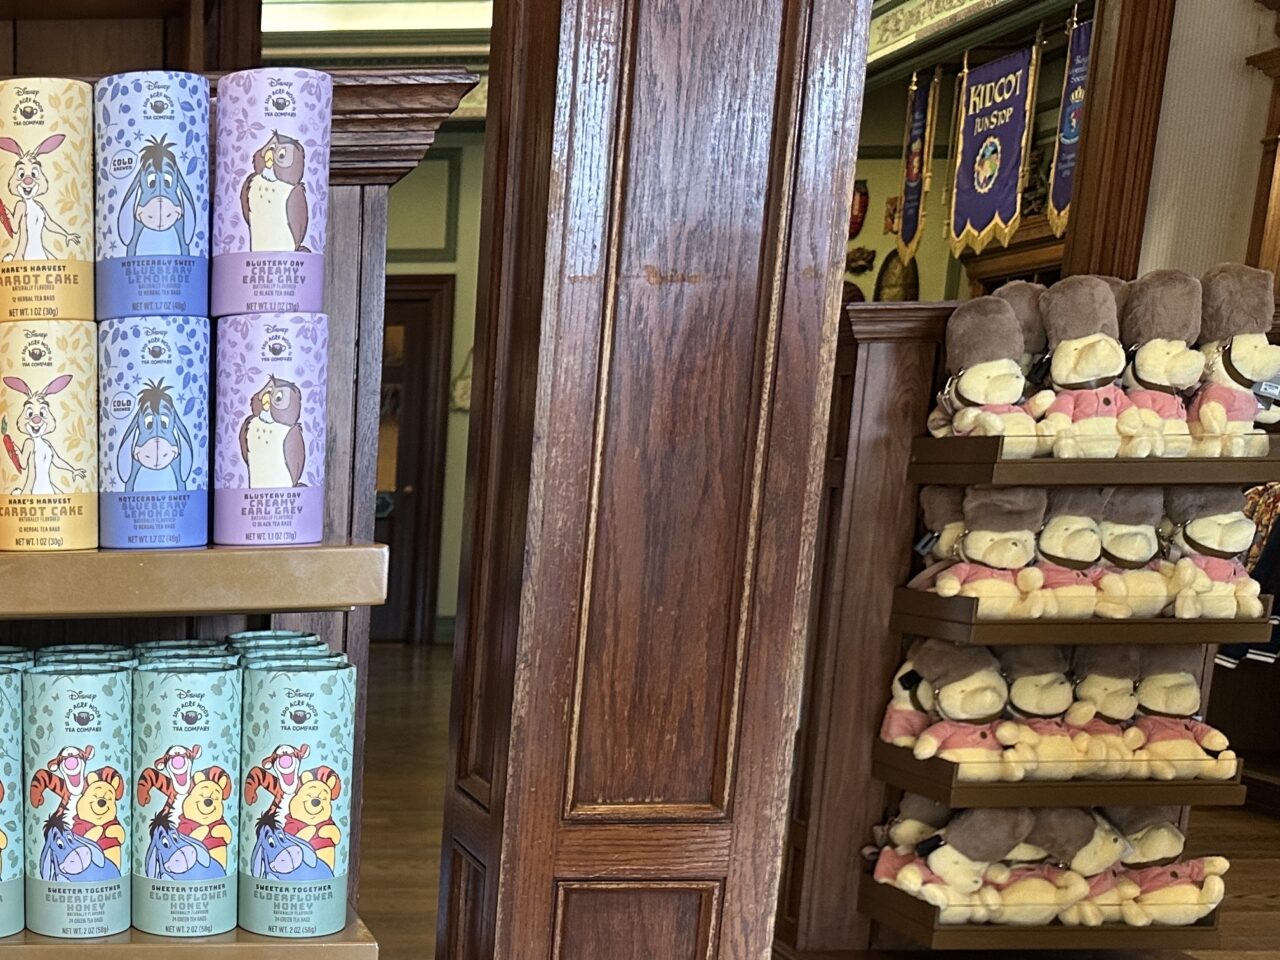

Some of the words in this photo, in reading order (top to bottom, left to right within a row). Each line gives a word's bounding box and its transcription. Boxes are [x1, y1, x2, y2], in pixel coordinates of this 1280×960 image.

[968, 69, 1022, 116] KIDCOT
[113, 158, 133, 166] COLD
[122, 260, 171, 268] NOTICEABLY
[251, 267, 299, 275] CREAMY
[46, 274, 79, 284] CAKE
[128, 275, 190, 284] LEMONADE
[243, 276, 273, 284] EARL
[278, 276, 306, 284] GREY
[122, 502, 187, 510] BLUEBERRY
[0, 507, 46, 516] CARROT
[51, 506, 83, 515] CAKE
[125, 510, 184, 518] LEMONADE
[275, 507, 303, 515] GREY
[85, 884, 121, 893] TOGETHER
[188, 884, 225, 892] TOGETHER
[256, 884, 289, 892] SWEETER
[46, 892, 122, 903] ELDERFLOWER
[150, 890, 227, 901] ELDERFLOWER
[254, 891, 333, 902] ELDERFLOWER
[67, 903, 105, 911] HONEY
[171, 902, 209, 910] HONEY
[274, 902, 313, 910] HONEY
